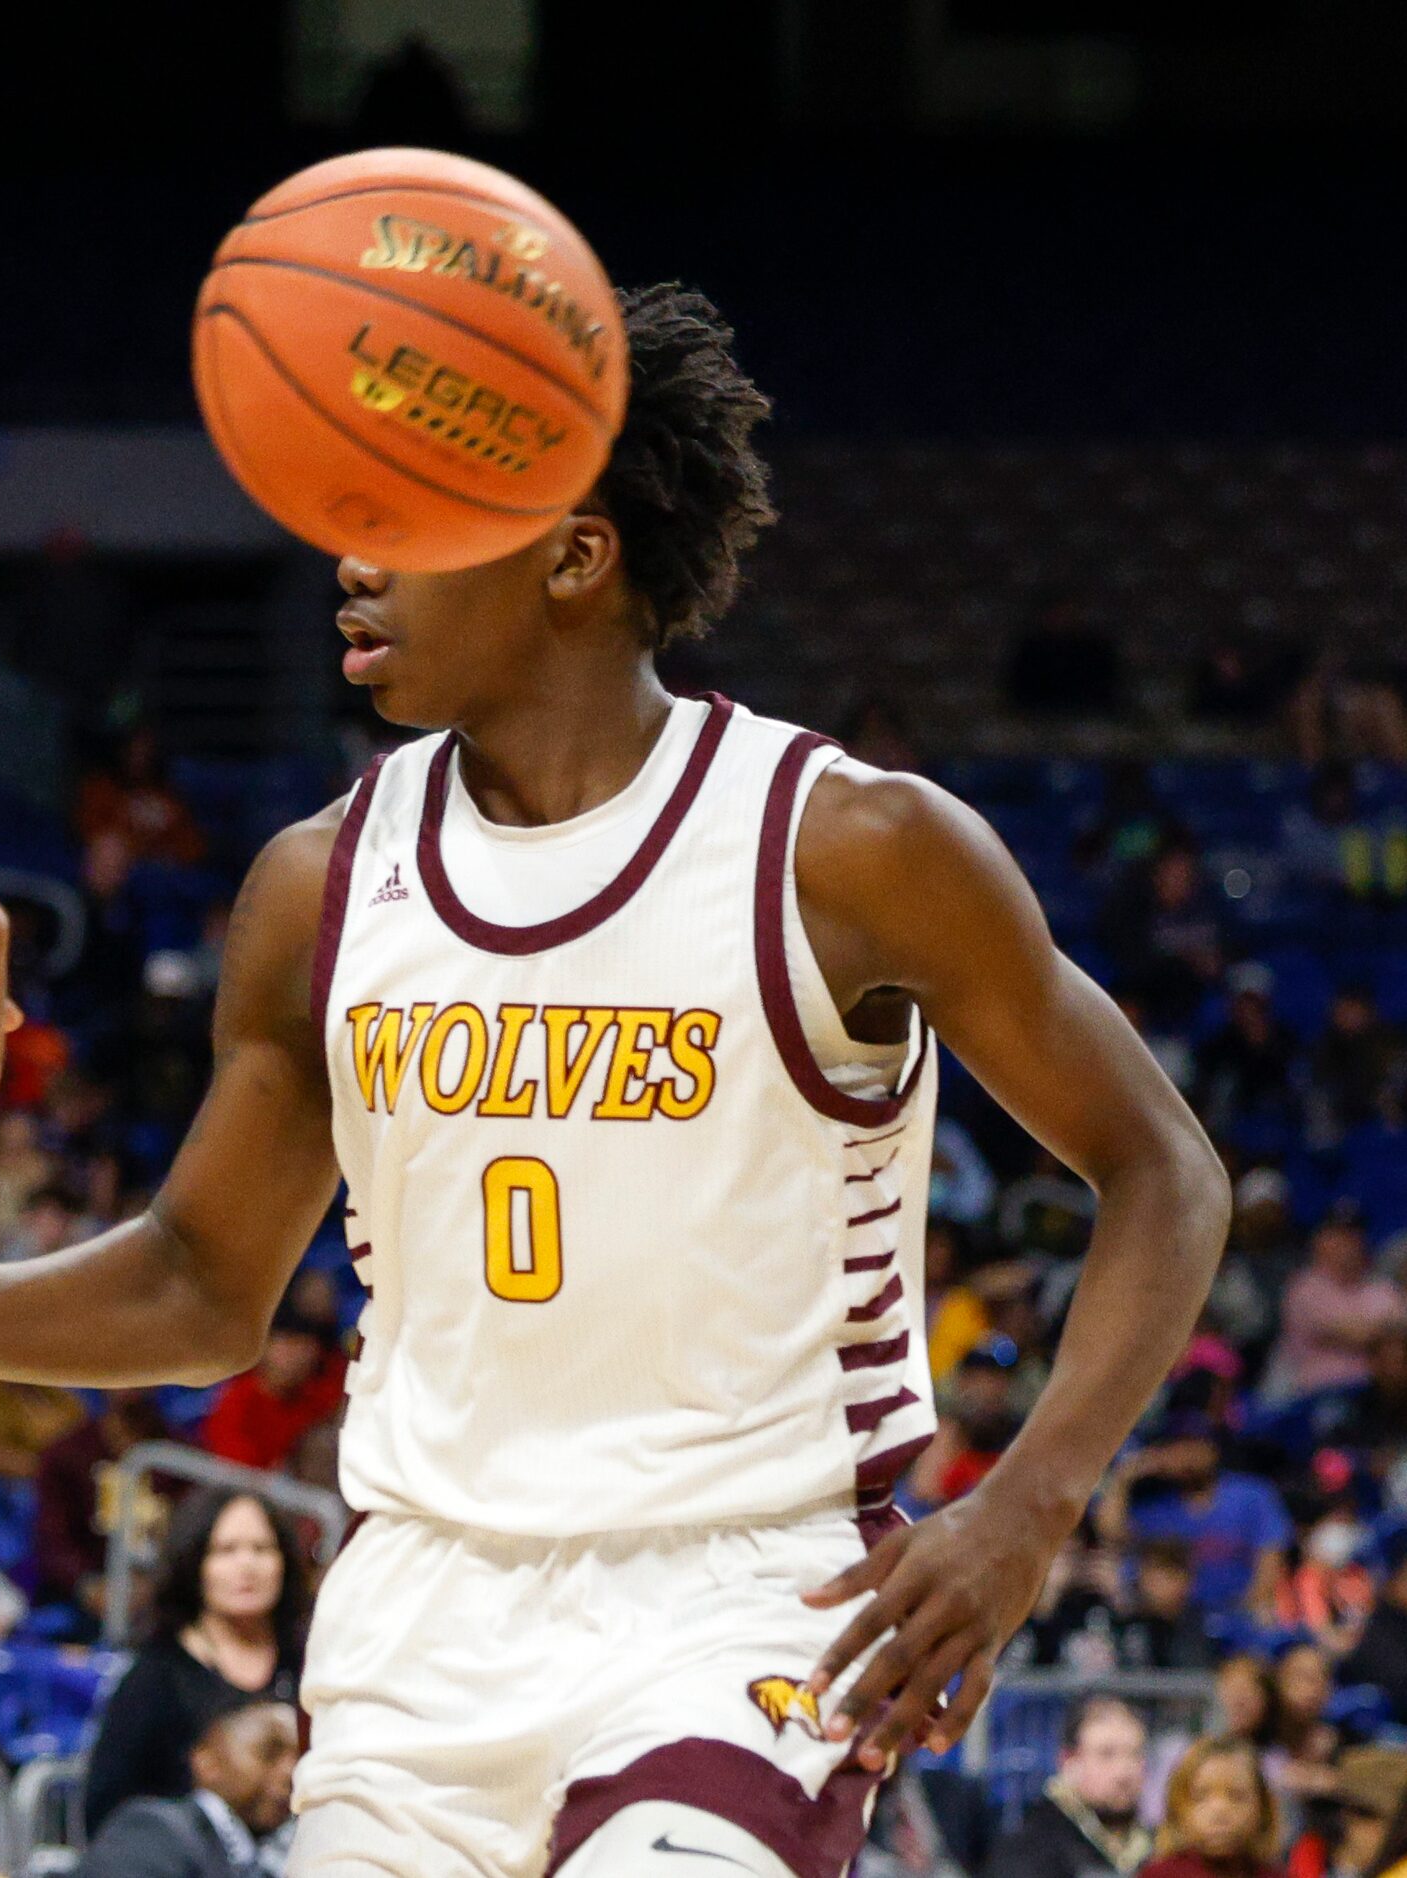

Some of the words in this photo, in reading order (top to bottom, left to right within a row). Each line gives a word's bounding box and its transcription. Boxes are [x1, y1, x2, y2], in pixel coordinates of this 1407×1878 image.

[349, 321, 567, 449] LEGACY
[346, 1001, 723, 1122] WOLVES
[481, 1155, 563, 1303] 0
